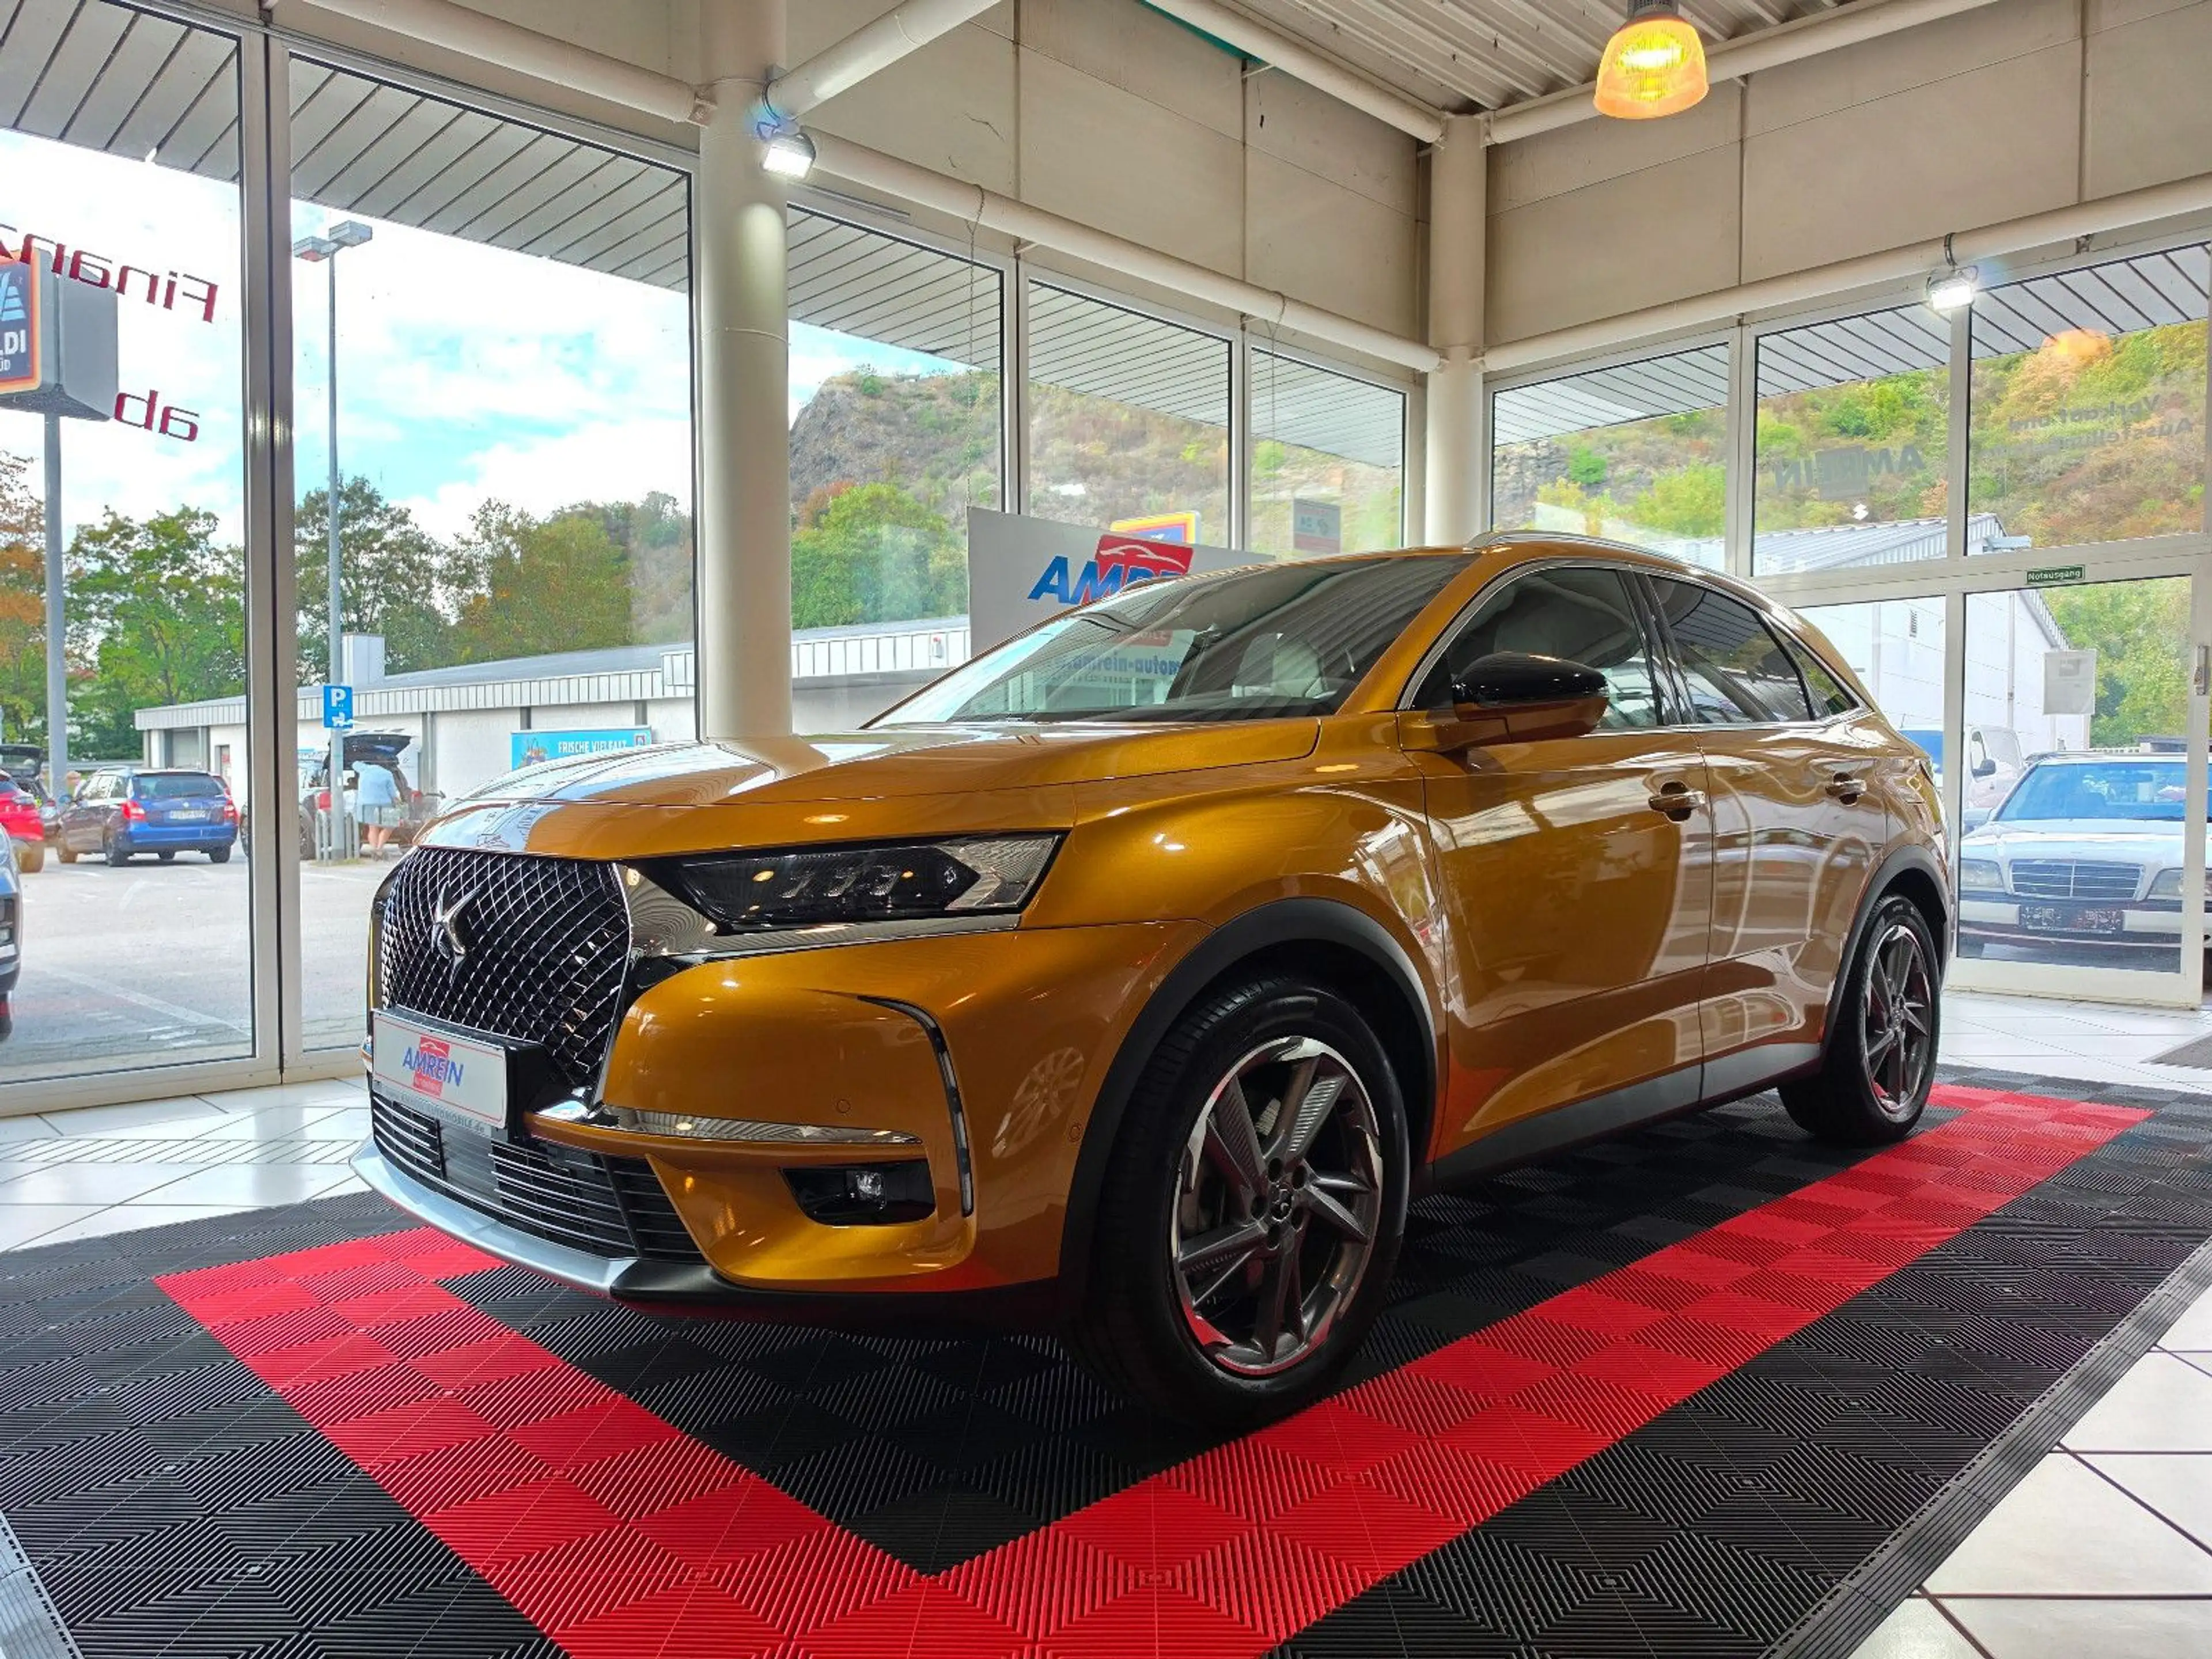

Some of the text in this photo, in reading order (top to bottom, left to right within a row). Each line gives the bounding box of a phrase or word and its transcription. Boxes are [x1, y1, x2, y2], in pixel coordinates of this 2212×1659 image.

[0, 329, 26, 355] DI
[2028, 569, 2081, 581] Notausgang
[330, 687, 346, 707] P
[558, 740, 590, 753] FRISCHE
[403, 1046, 464, 1088] AMREIN
